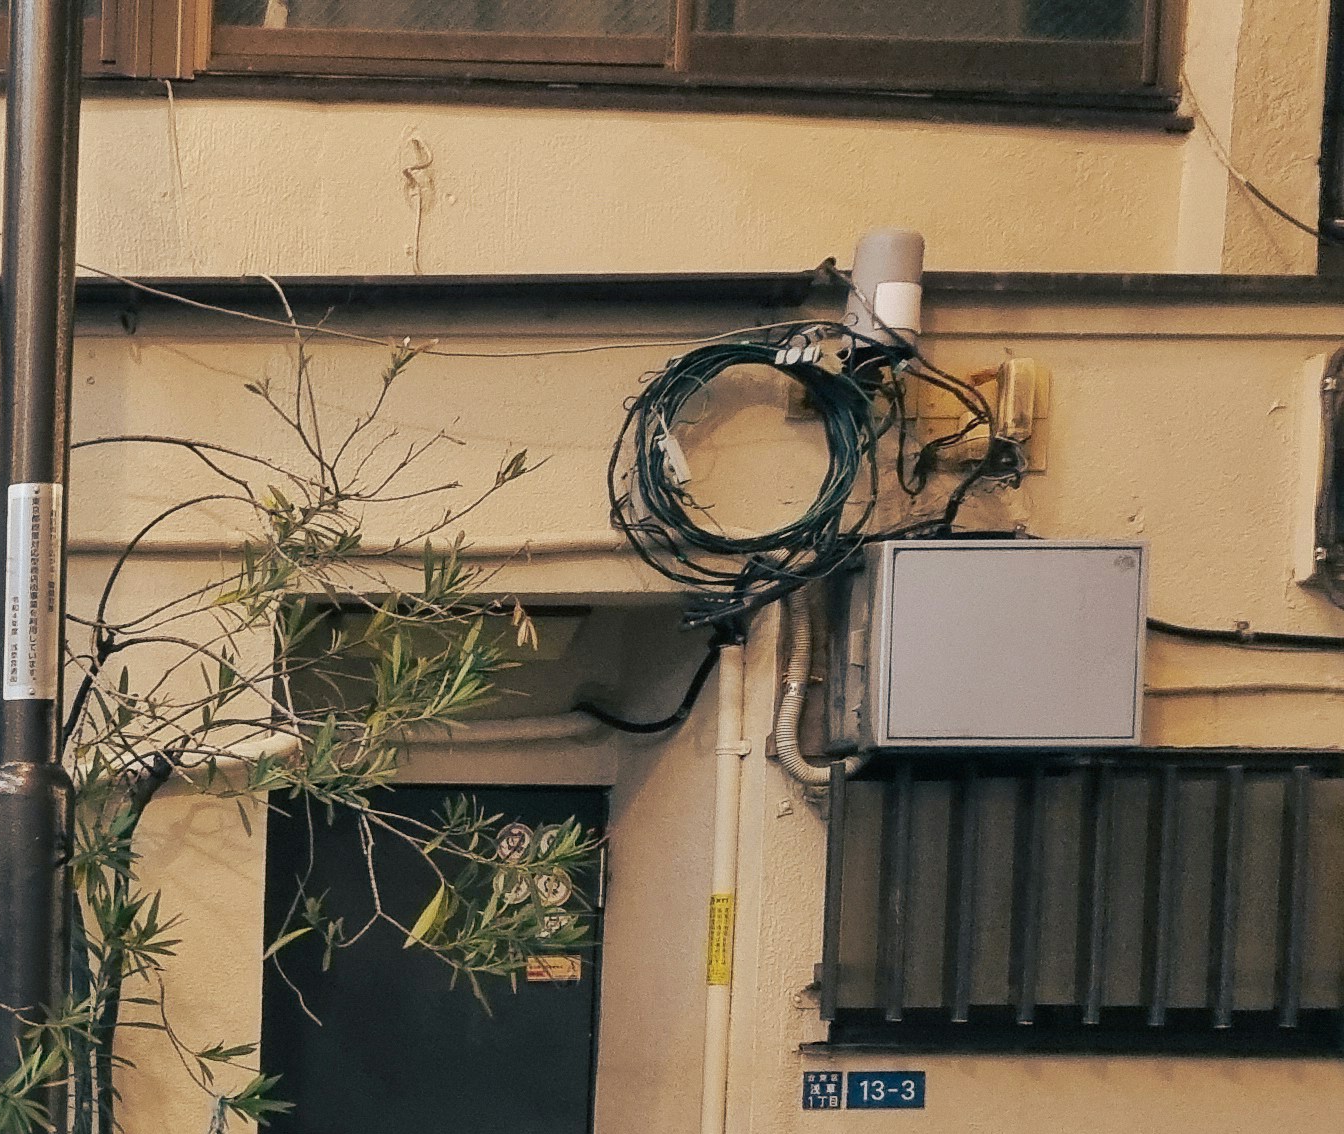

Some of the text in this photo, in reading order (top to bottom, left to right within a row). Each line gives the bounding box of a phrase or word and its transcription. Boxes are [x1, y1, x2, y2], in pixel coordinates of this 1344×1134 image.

[810, 1083, 837, 1095] 浅草
[859, 1080, 916, 1102] 13-3
[807, 1096, 838, 1107] 1丁目
